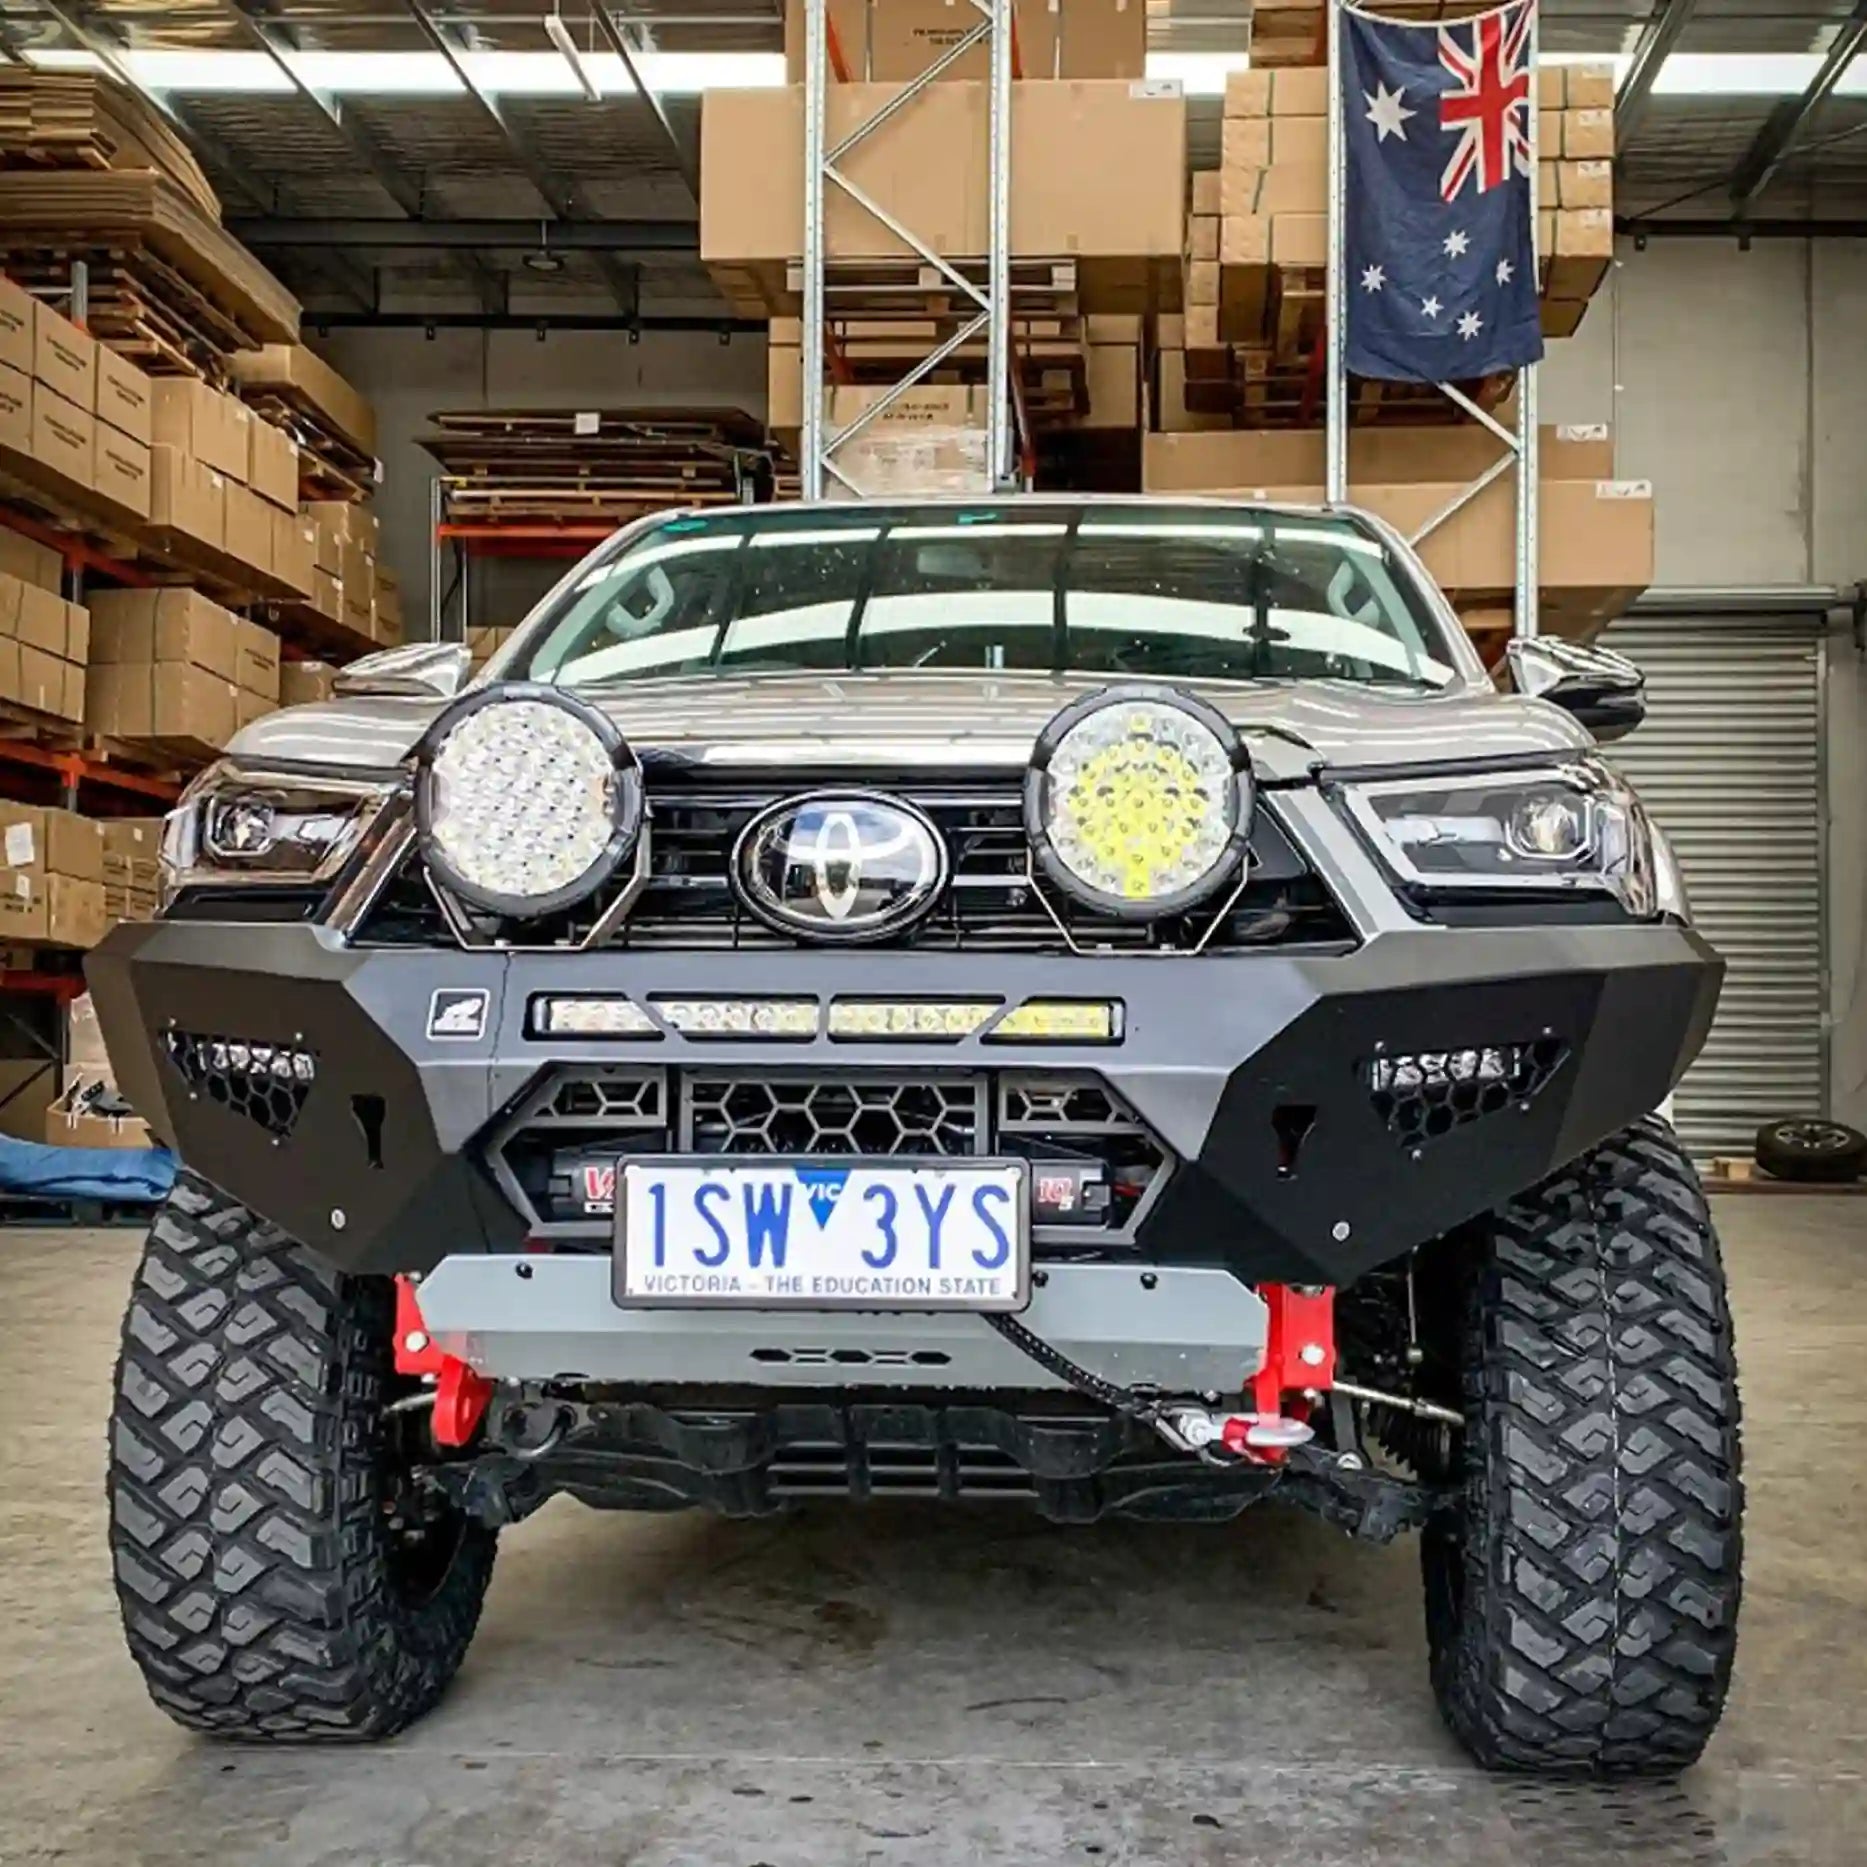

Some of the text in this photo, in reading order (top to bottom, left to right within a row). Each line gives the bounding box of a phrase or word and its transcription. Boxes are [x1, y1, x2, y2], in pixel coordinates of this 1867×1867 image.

[804, 1183, 842, 1201] VIC
[649, 1182, 1010, 1270] 1SW 3YS
[645, 1275, 741, 1293] VICTORIA
[765, 1276, 803, 1293] THE
[811, 1277, 931, 1295] EDUCATION
[938, 1278, 1002, 1295] STATE
